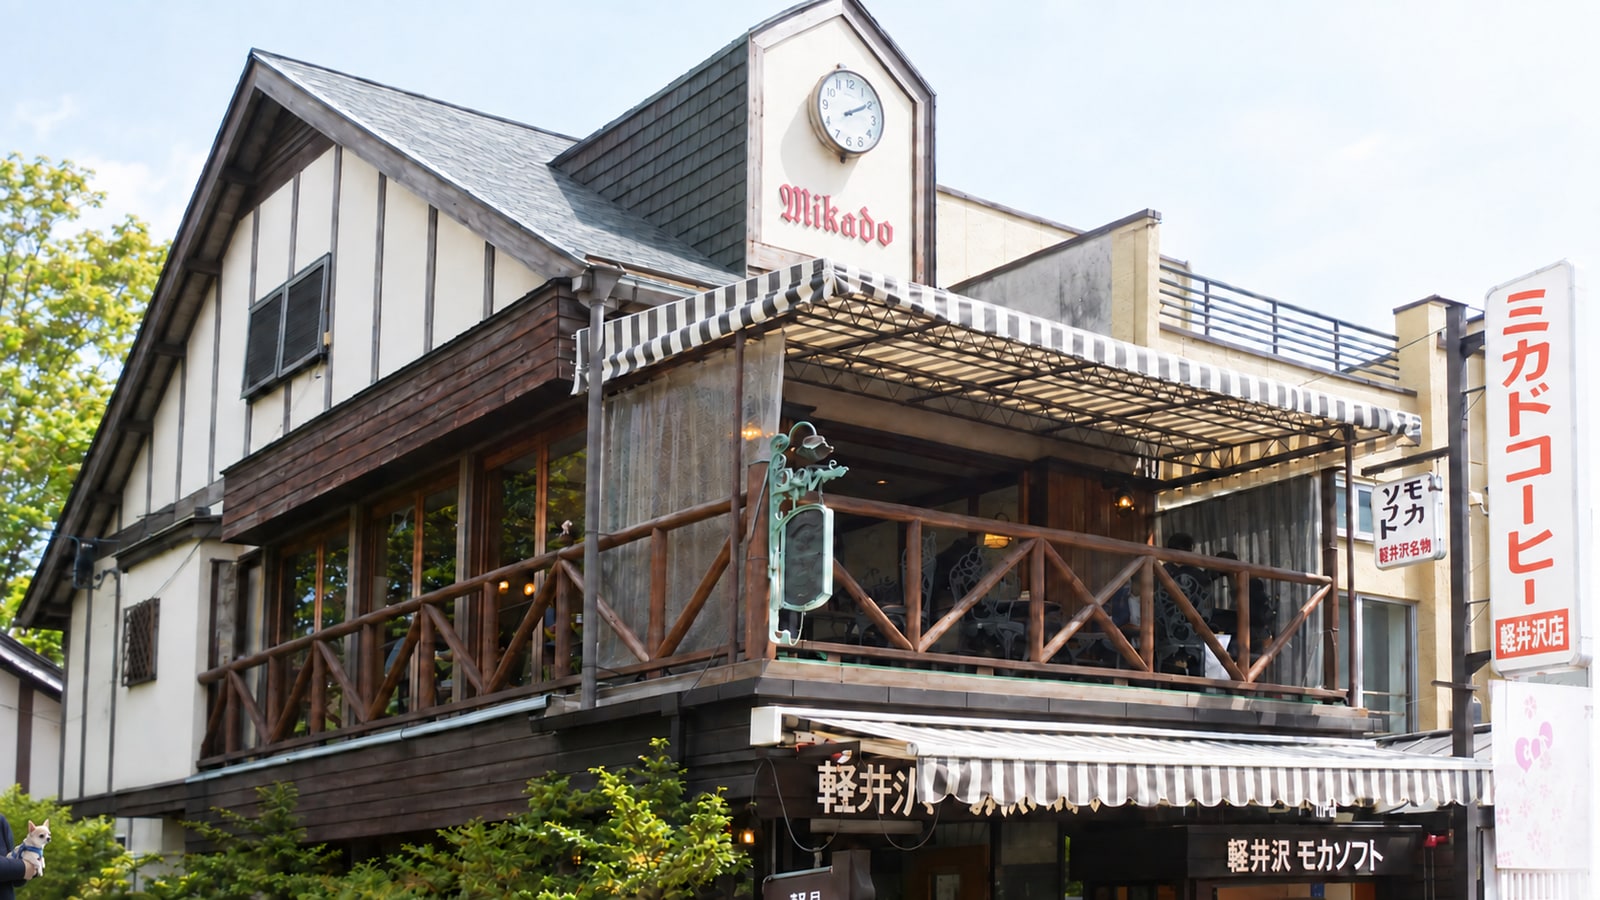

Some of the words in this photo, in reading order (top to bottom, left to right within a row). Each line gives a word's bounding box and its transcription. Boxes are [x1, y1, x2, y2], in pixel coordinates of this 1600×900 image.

[827, 87, 836, 97] 10
[846, 79, 855, 89] 12
[822, 99, 829, 110] 9
[866, 100, 873, 110] 2
[871, 115, 877, 126] 3
[845, 136, 852, 147] 6
[779, 184, 893, 247] Mikado
[1502, 289, 1554, 605] ミカドコーヒー
[1380, 485, 1400, 540] ソフト
[1403, 480, 1424, 526] モカ
[1379, 537, 1431, 564] 軽井沢名物
[1500, 615, 1564, 654] 軽井沢店
[1227, 838, 1291, 873] 軽井沢
[1297, 838, 1383, 872] モカソフト
